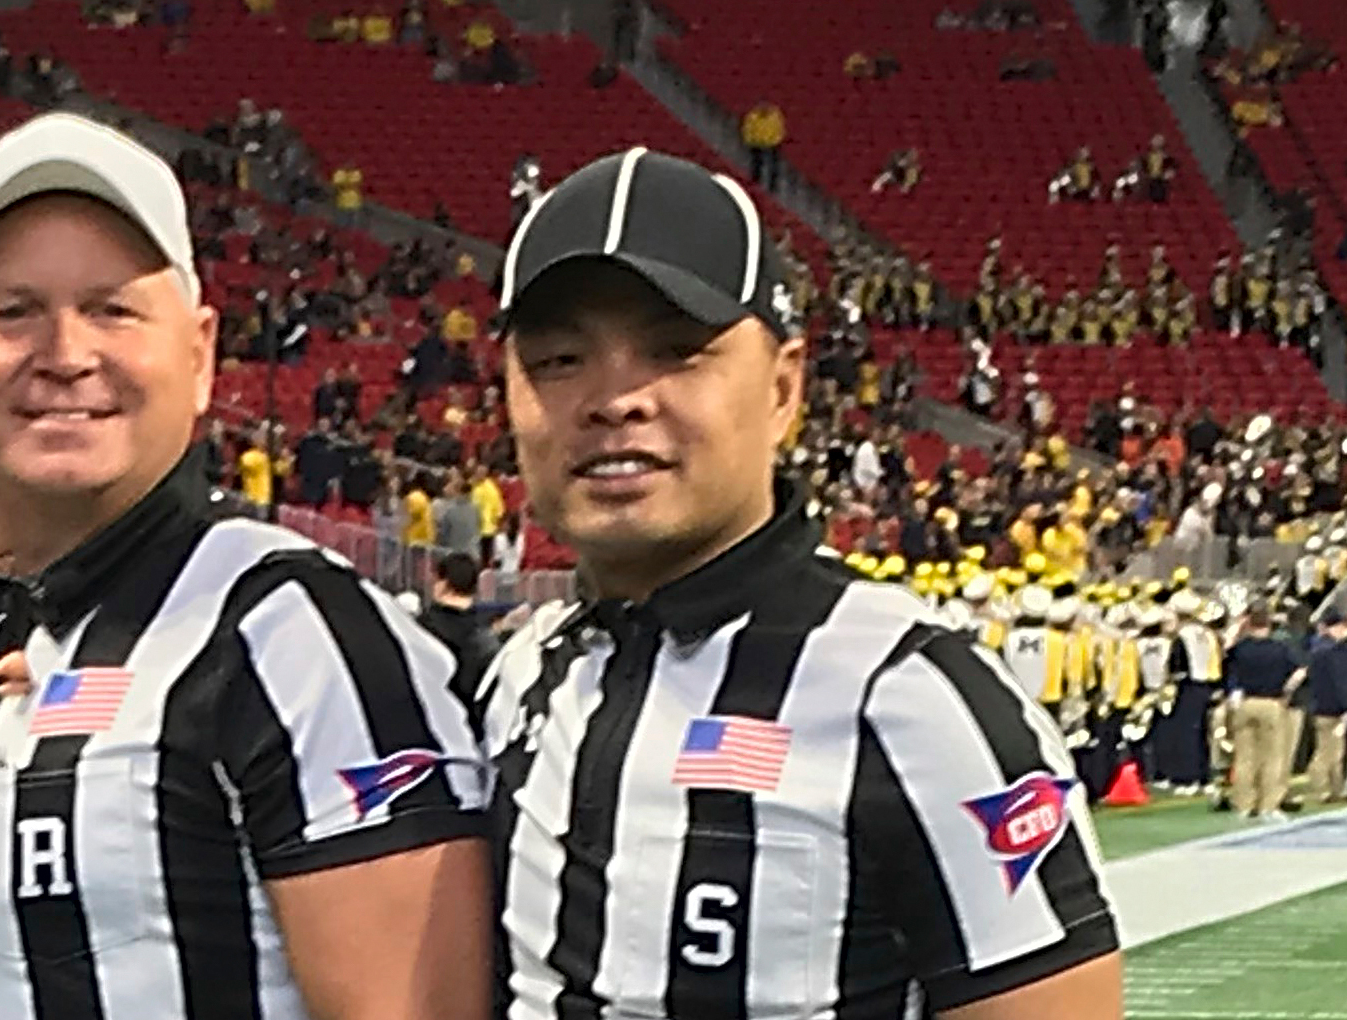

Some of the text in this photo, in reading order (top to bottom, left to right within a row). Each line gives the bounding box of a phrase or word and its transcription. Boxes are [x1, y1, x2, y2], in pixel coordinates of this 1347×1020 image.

[17, 817, 73, 898] R
[1007, 802, 1057, 846] CFO
[680, 882, 740, 967] S
